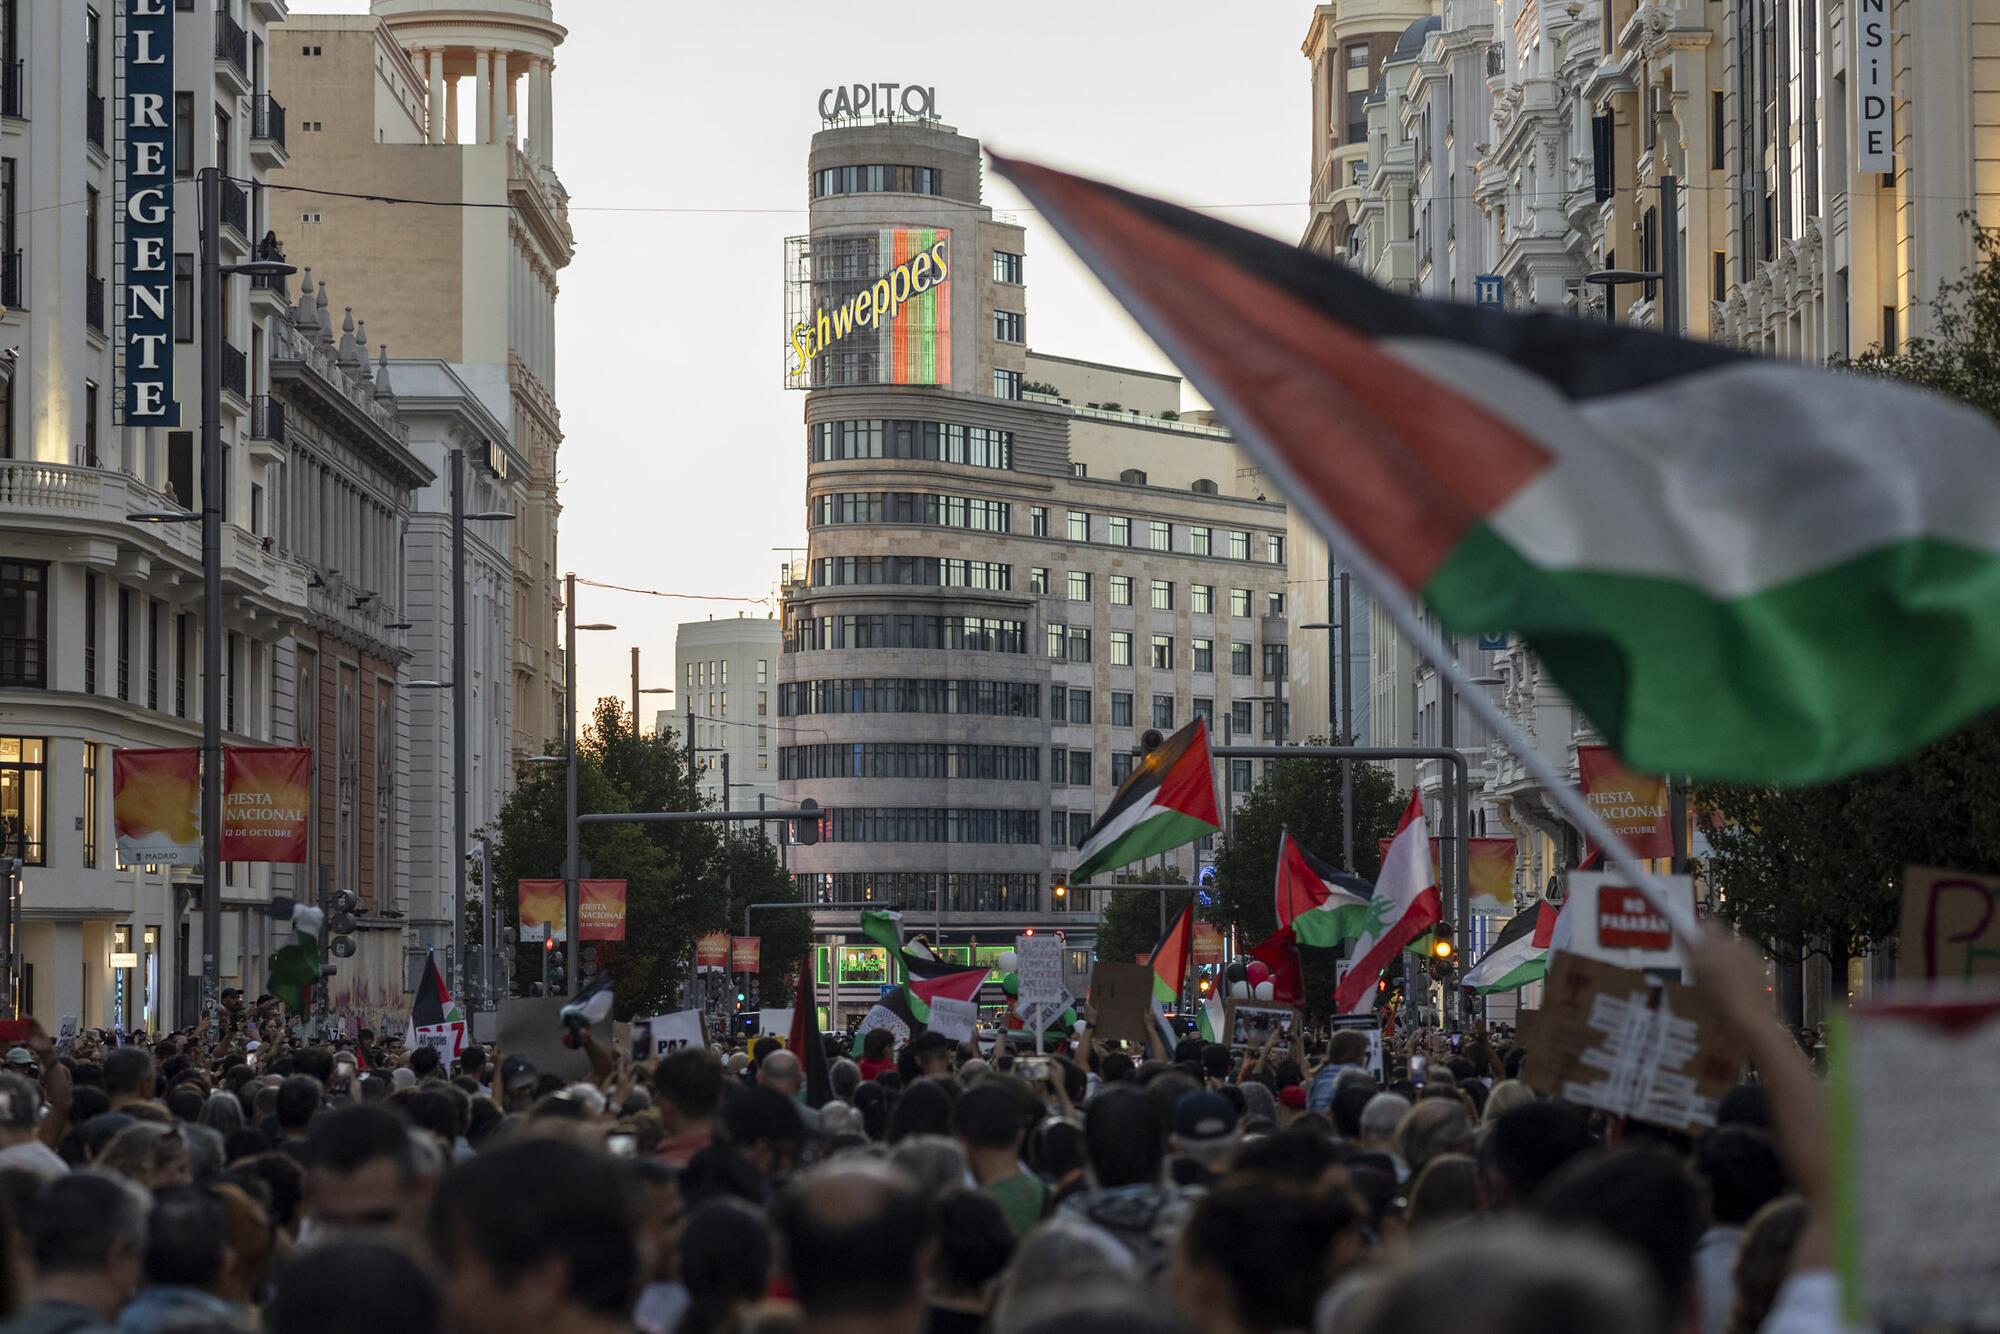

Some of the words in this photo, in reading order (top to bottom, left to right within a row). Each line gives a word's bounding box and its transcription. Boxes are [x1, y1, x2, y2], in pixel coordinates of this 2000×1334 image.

[818, 82, 942, 120] CAPITOL
[127, 94, 170, 416] REGENTE
[791, 238, 948, 377] Schweppes
[228, 793, 273, 805] FIESTA
[1587, 791, 1635, 805] FIESTA
[226, 808, 304, 822] NACIONAL
[225, 829, 234, 837] 12
[235, 829, 247, 837] DE
[249, 829, 292, 838] OCTUBRE
[1615, 826, 1657, 835] OCTUBRE
[145, 852, 178, 861] MADRID
[580, 911, 623, 919] NACIONAL
